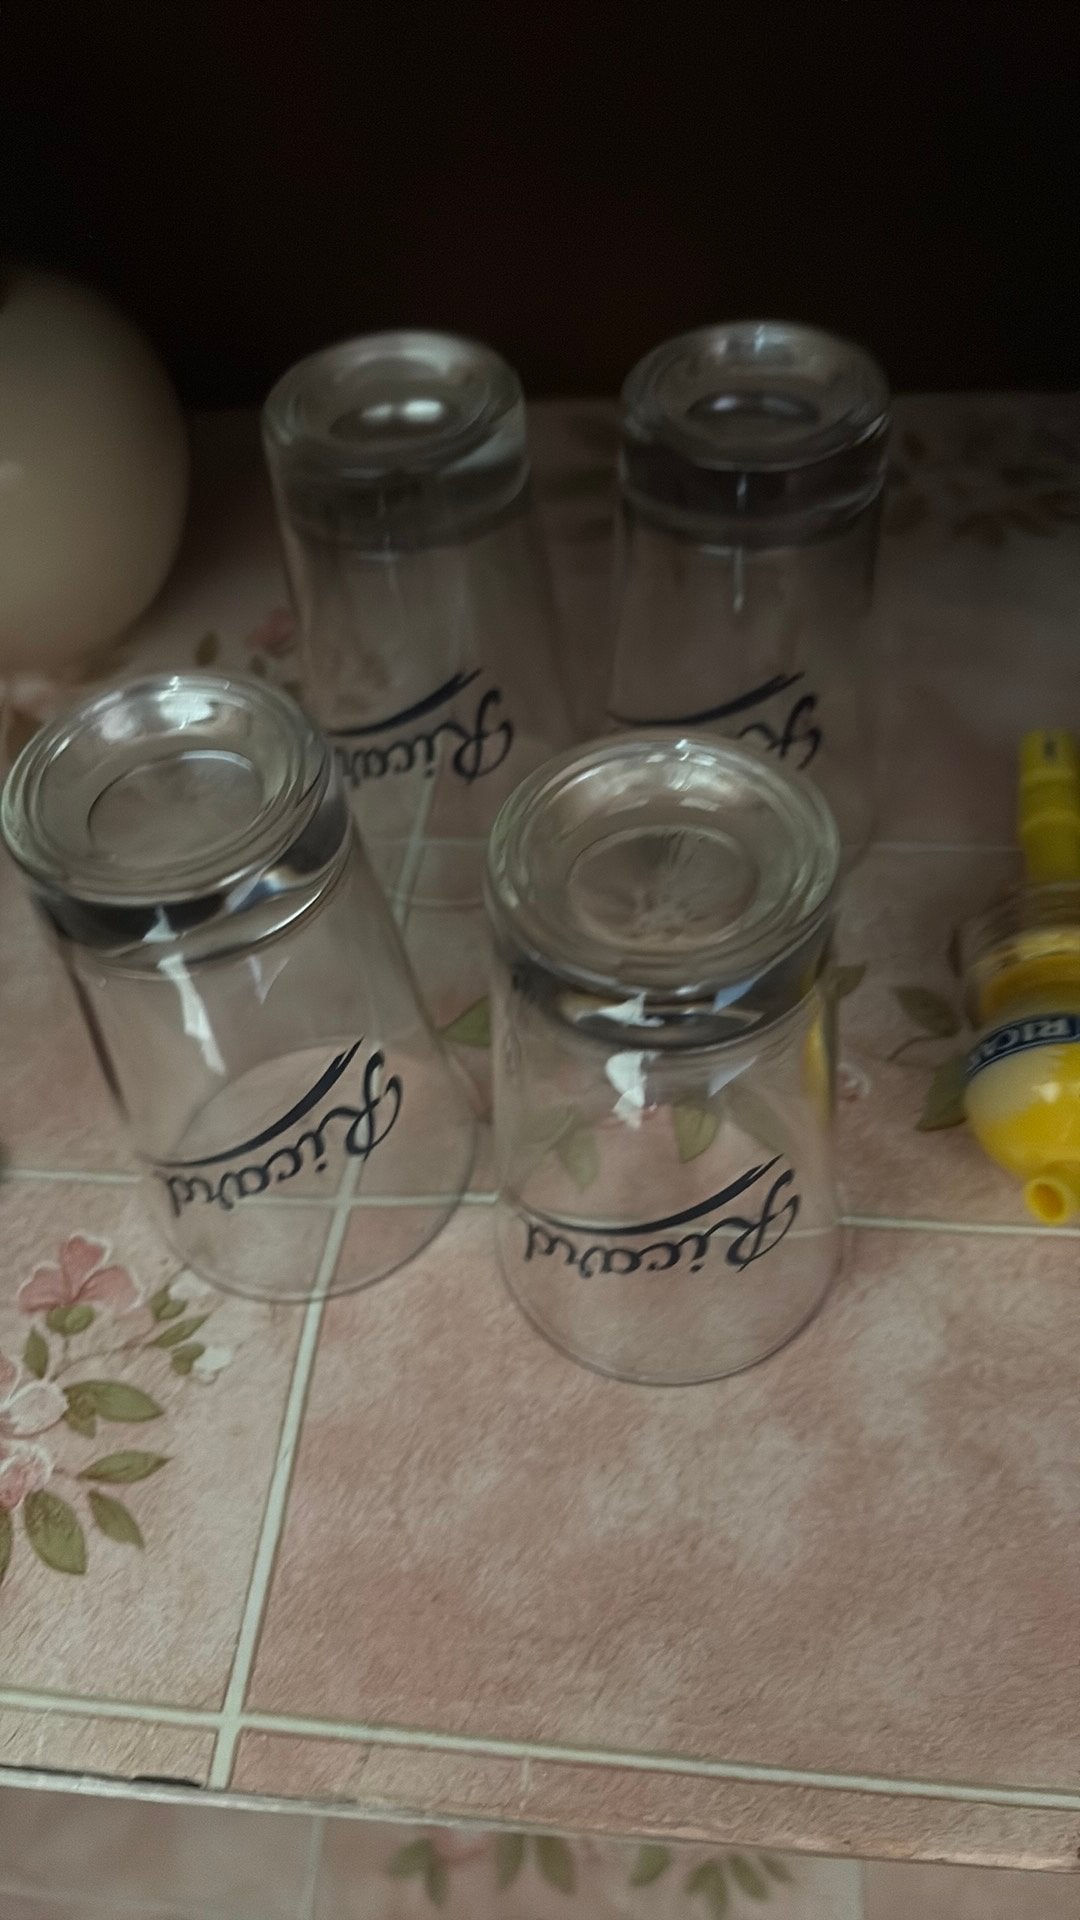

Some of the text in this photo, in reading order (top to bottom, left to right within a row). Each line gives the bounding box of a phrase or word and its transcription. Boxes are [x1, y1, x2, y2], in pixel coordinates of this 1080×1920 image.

[335, 689, 514, 789] Ricar
[156, 1048, 402, 1218] Ricard
[520, 1167, 801, 1279] Ricard
